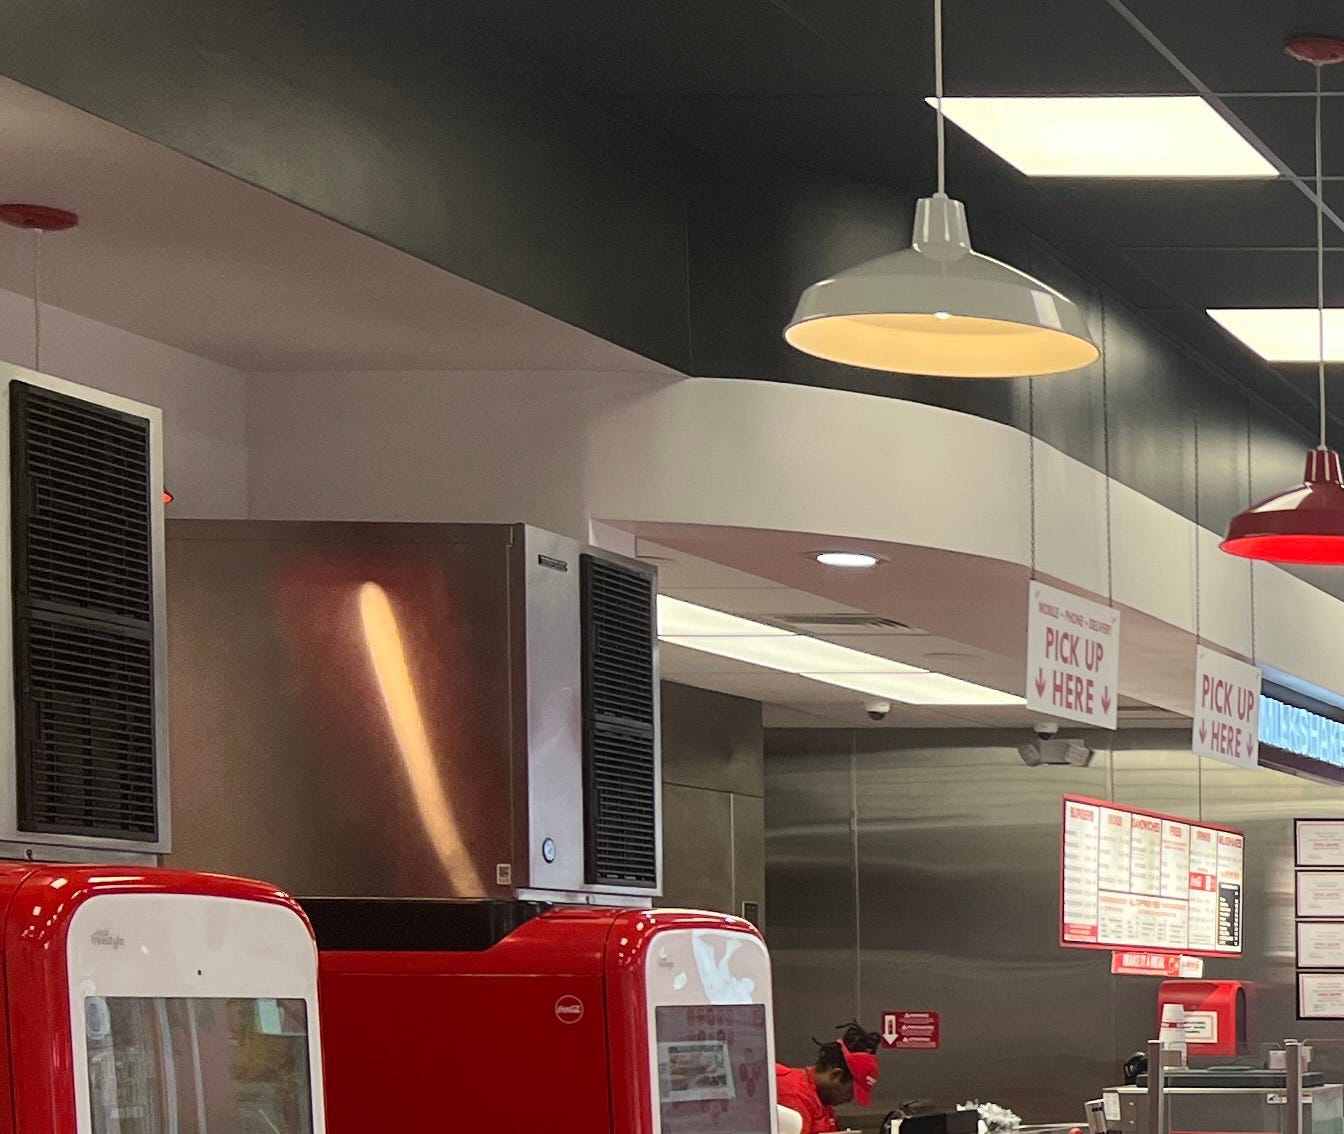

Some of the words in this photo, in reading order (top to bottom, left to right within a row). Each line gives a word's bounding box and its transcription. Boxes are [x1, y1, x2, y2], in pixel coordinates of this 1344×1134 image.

[1046, 626, 1079, 667] PICK
[1085, 639, 1104, 672] UP
[1053, 670, 1094, 715] HERE
[1202, 674, 1232, 718] PICK
[1238, 687, 1255, 722] UP
[1211, 720, 1241, 758] HERE
